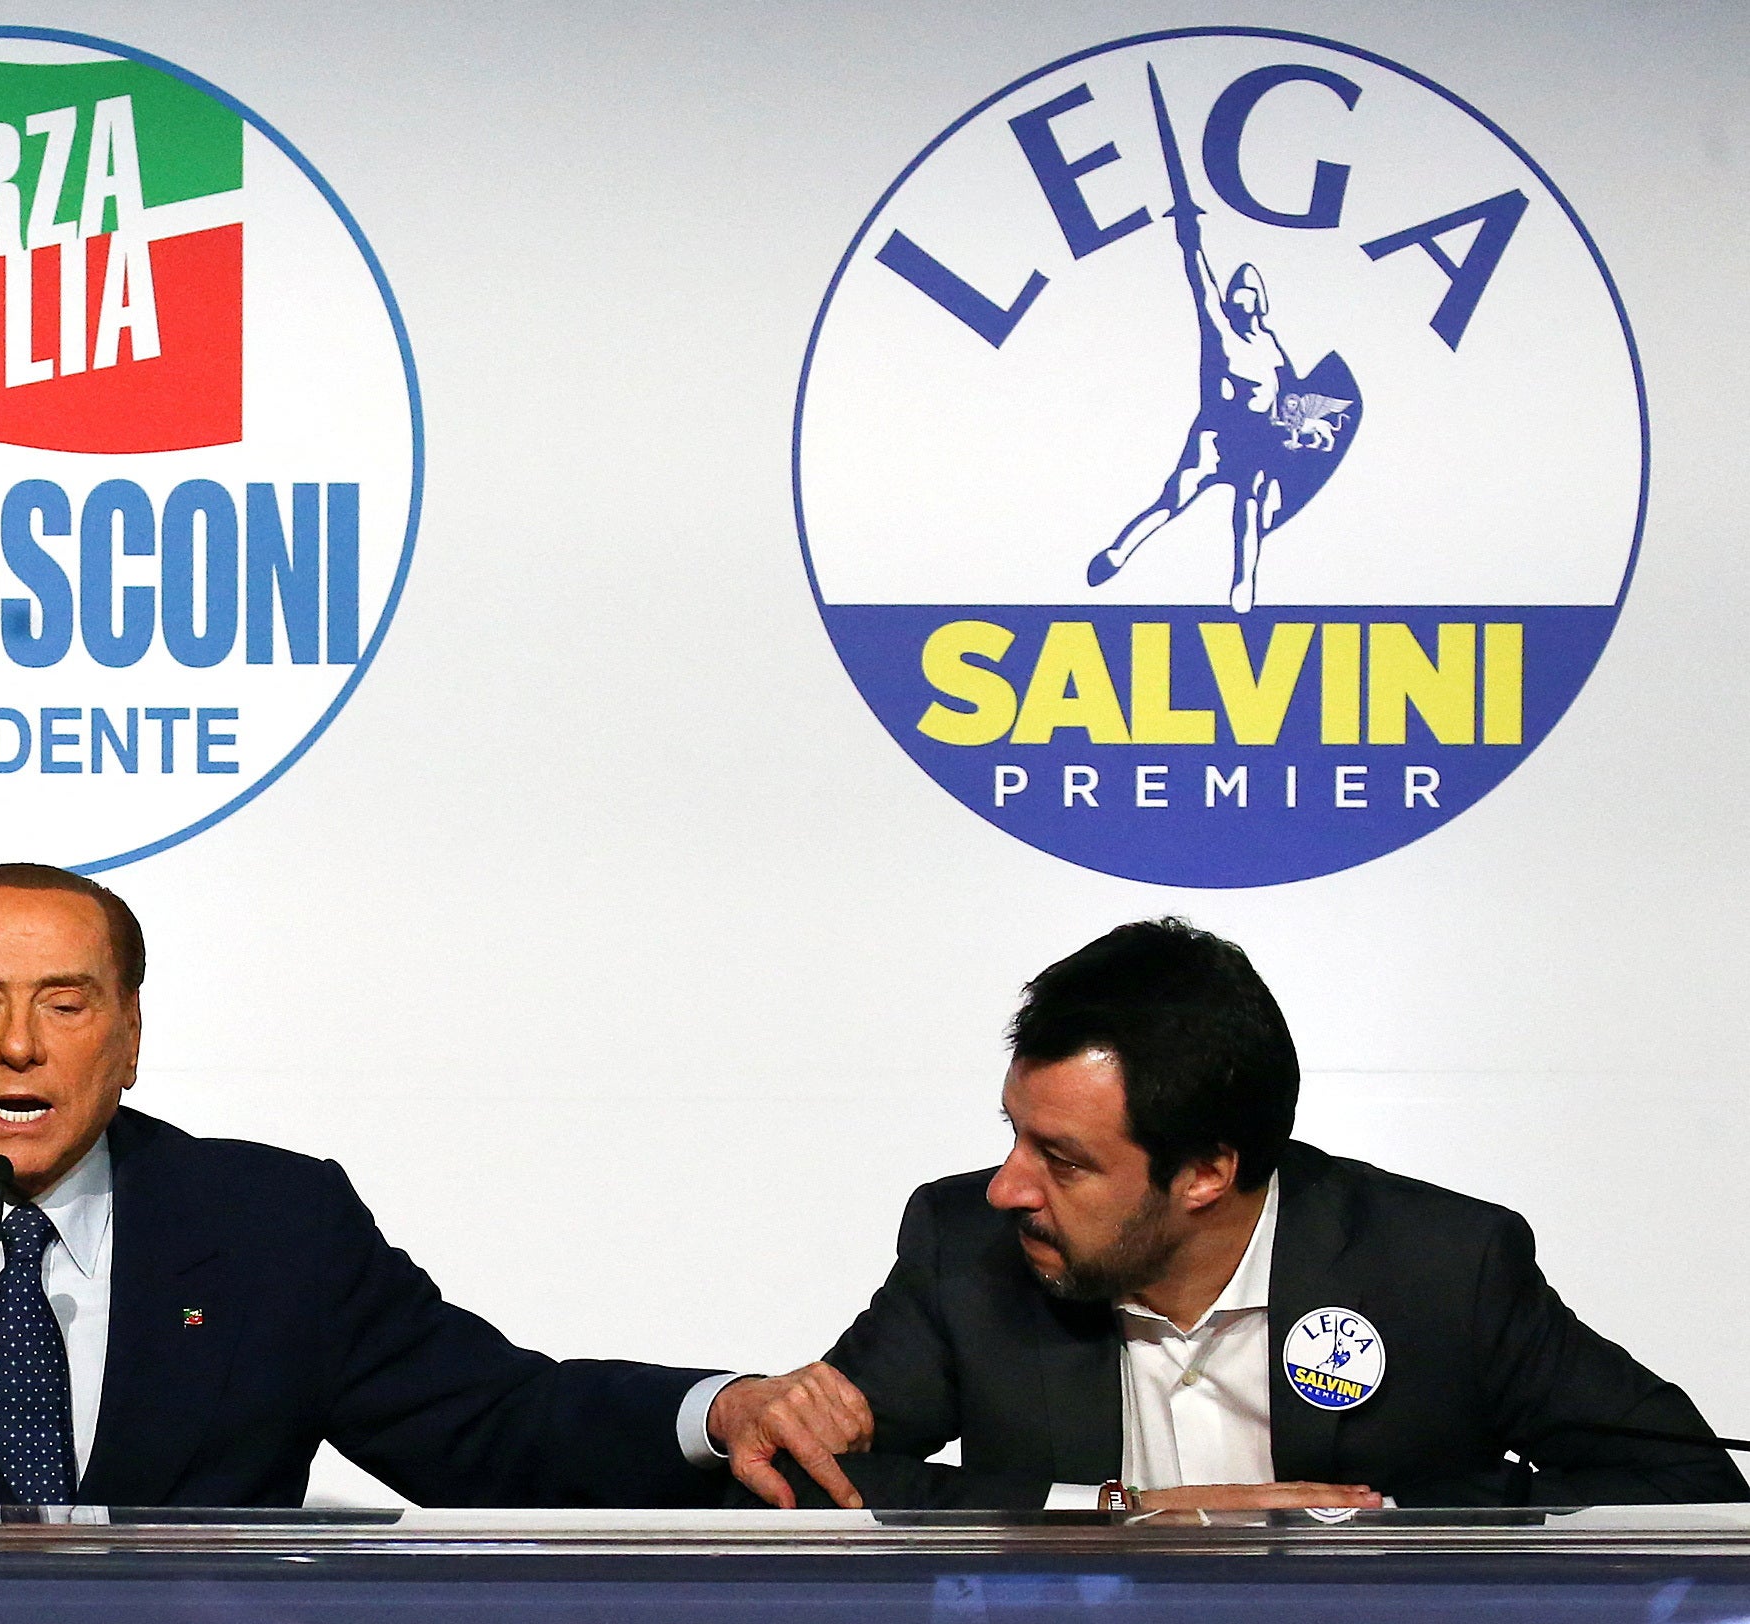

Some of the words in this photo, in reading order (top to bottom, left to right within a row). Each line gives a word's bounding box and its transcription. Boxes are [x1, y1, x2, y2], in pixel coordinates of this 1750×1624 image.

[874, 64, 1531, 352] LEGA
[917, 621, 1523, 746] SALVINI
[995, 766, 1440, 808] PREMIER
[1302, 1314, 1374, 1354] LEGA
[1294, 1367, 1363, 1399] SALVINI
[1299, 1385, 1350, 1404] PREMIER
